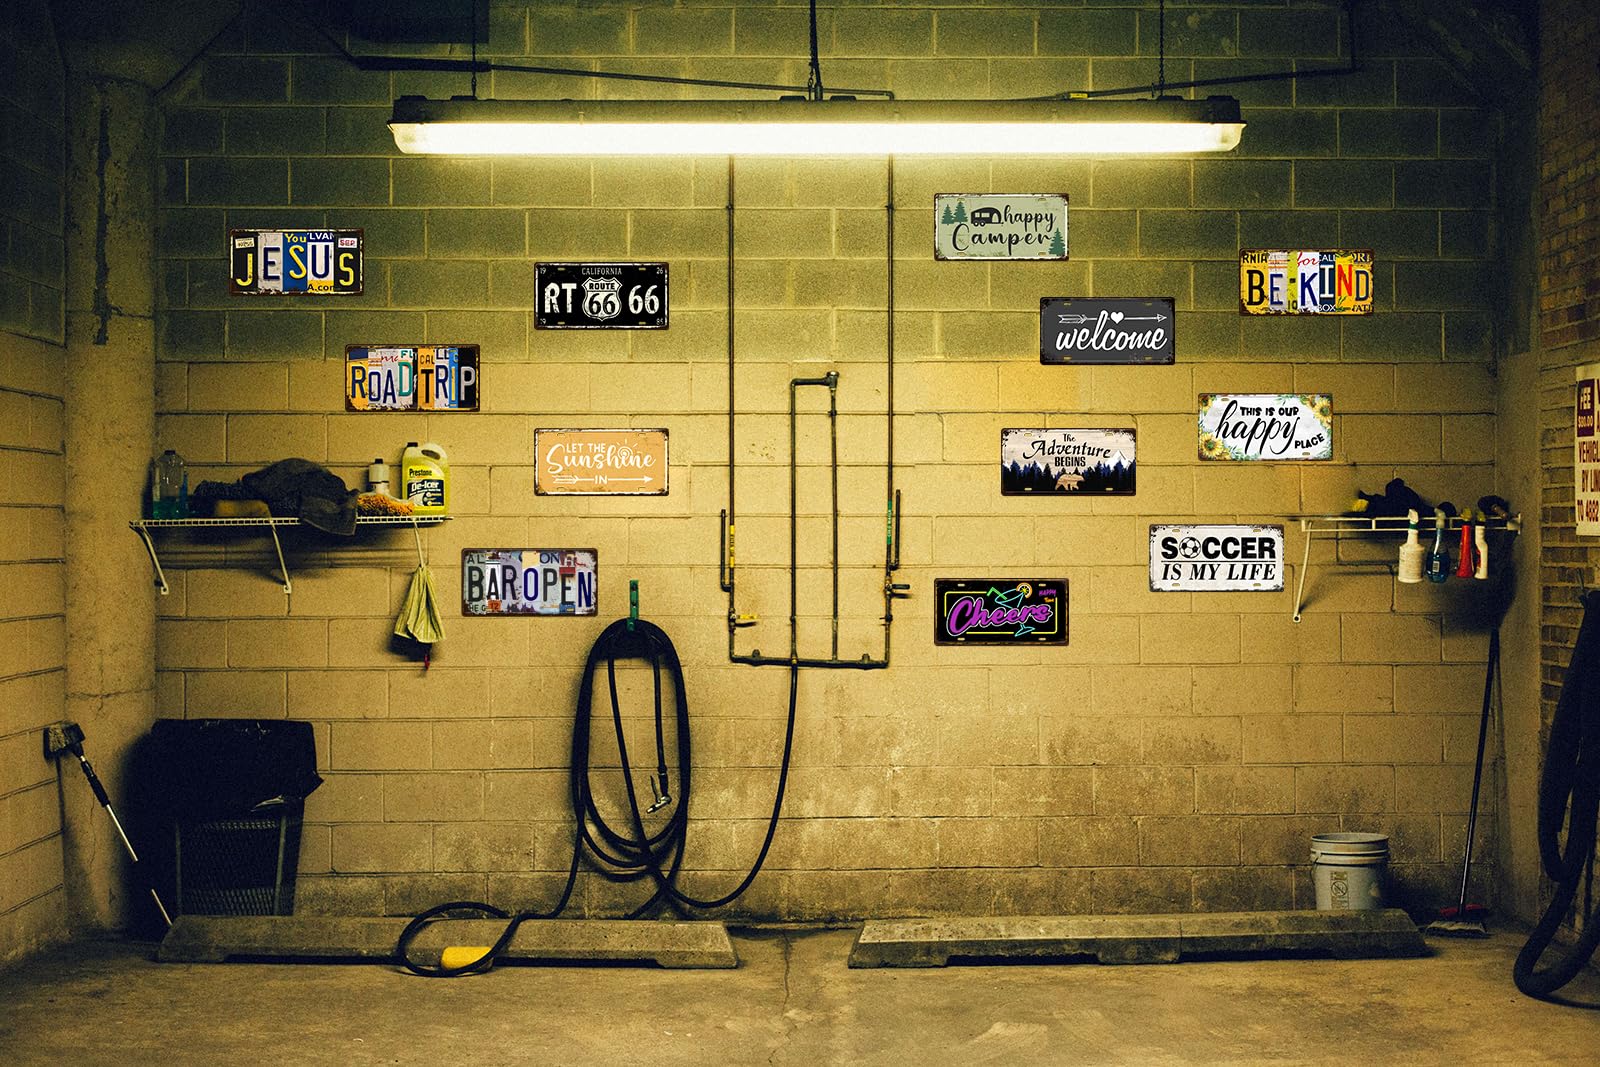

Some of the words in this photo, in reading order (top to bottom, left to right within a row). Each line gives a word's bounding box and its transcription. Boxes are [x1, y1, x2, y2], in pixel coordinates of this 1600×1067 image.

[1003, 204, 1056, 232] happy
[952, 223, 1052, 256] Camper
[236, 244, 354, 287] JESUS
[581, 267, 622, 275] CALIFORNIA
[588, 282, 616, 290] ROUTE
[544, 282, 577, 314] RT
[588, 292, 616, 315] 66
[628, 285, 660, 315] 66
[1055, 310, 1168, 351] welcome
[351, 361, 413, 404] ROAD
[421, 364, 476, 404] TRIP
[1580, 386, 1592, 410] FEE
[1240, 406, 1262, 416] THIS
[1265, 406, 1275, 416] IS
[1278, 406, 1299, 416] OUR
[1063, 433, 1076, 443] The
[1215, 399, 1300, 455] happy
[566, 443, 584, 453] LET
[587, 443, 606, 453] THE
[1022, 439, 1111, 459] Adventure
[1294, 433, 1325, 449] PLACE
[546, 443, 657, 474] Sunshine
[1054, 456, 1086, 467] BEGINS
[594, 475, 608, 485] IN
[1161, 563, 1182, 581] IS
[1189, 563, 1221, 581] MY
[1226, 563, 1276, 581] LIFE
[945, 595, 1054, 637] Cheers
